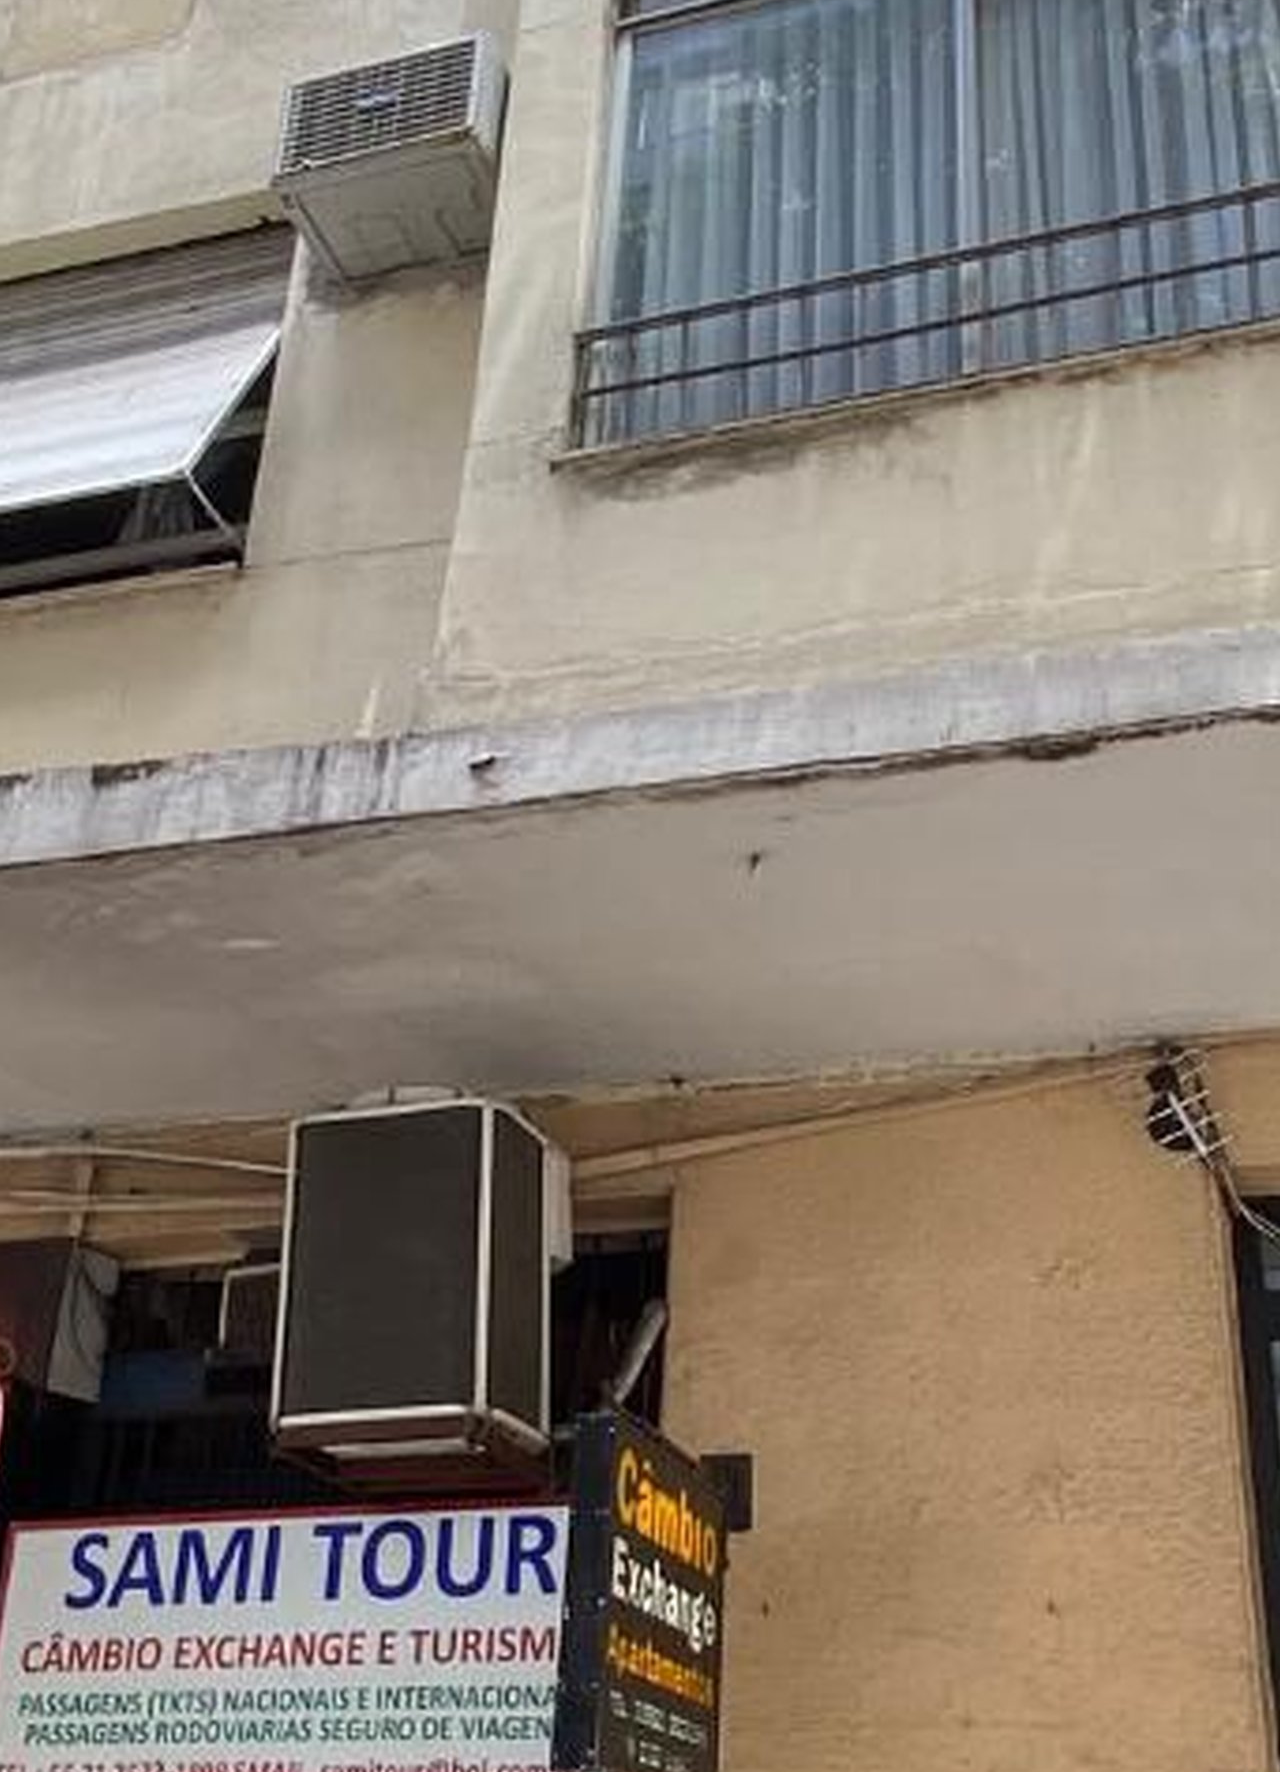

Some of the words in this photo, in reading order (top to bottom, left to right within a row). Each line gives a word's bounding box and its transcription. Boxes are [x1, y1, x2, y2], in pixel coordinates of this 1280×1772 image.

[65, 1525, 281, 1610] SAMI
[313, 1515, 560, 1602] TOUR
[611, 1535, 716, 1653] Exchange
[23, 1633, 162, 1675] CÂMBIO
[174, 1631, 364, 1669] EXCHANGE
[378, 1630, 396, 1665] E
[413, 1626, 557, 1663] TURISM
[21, 1693, 141, 1717] PASSAGENS
[223, 1686, 349, 1714] NACIONAIS
[358, 1686, 369, 1709] E
[377, 1684, 557, 1710] INTERNACIONA
[25, 1722, 149, 1745] PASSAGENS
[319, 1715, 415, 1741] SEGURO
[422, 1715, 453, 1740] DE
